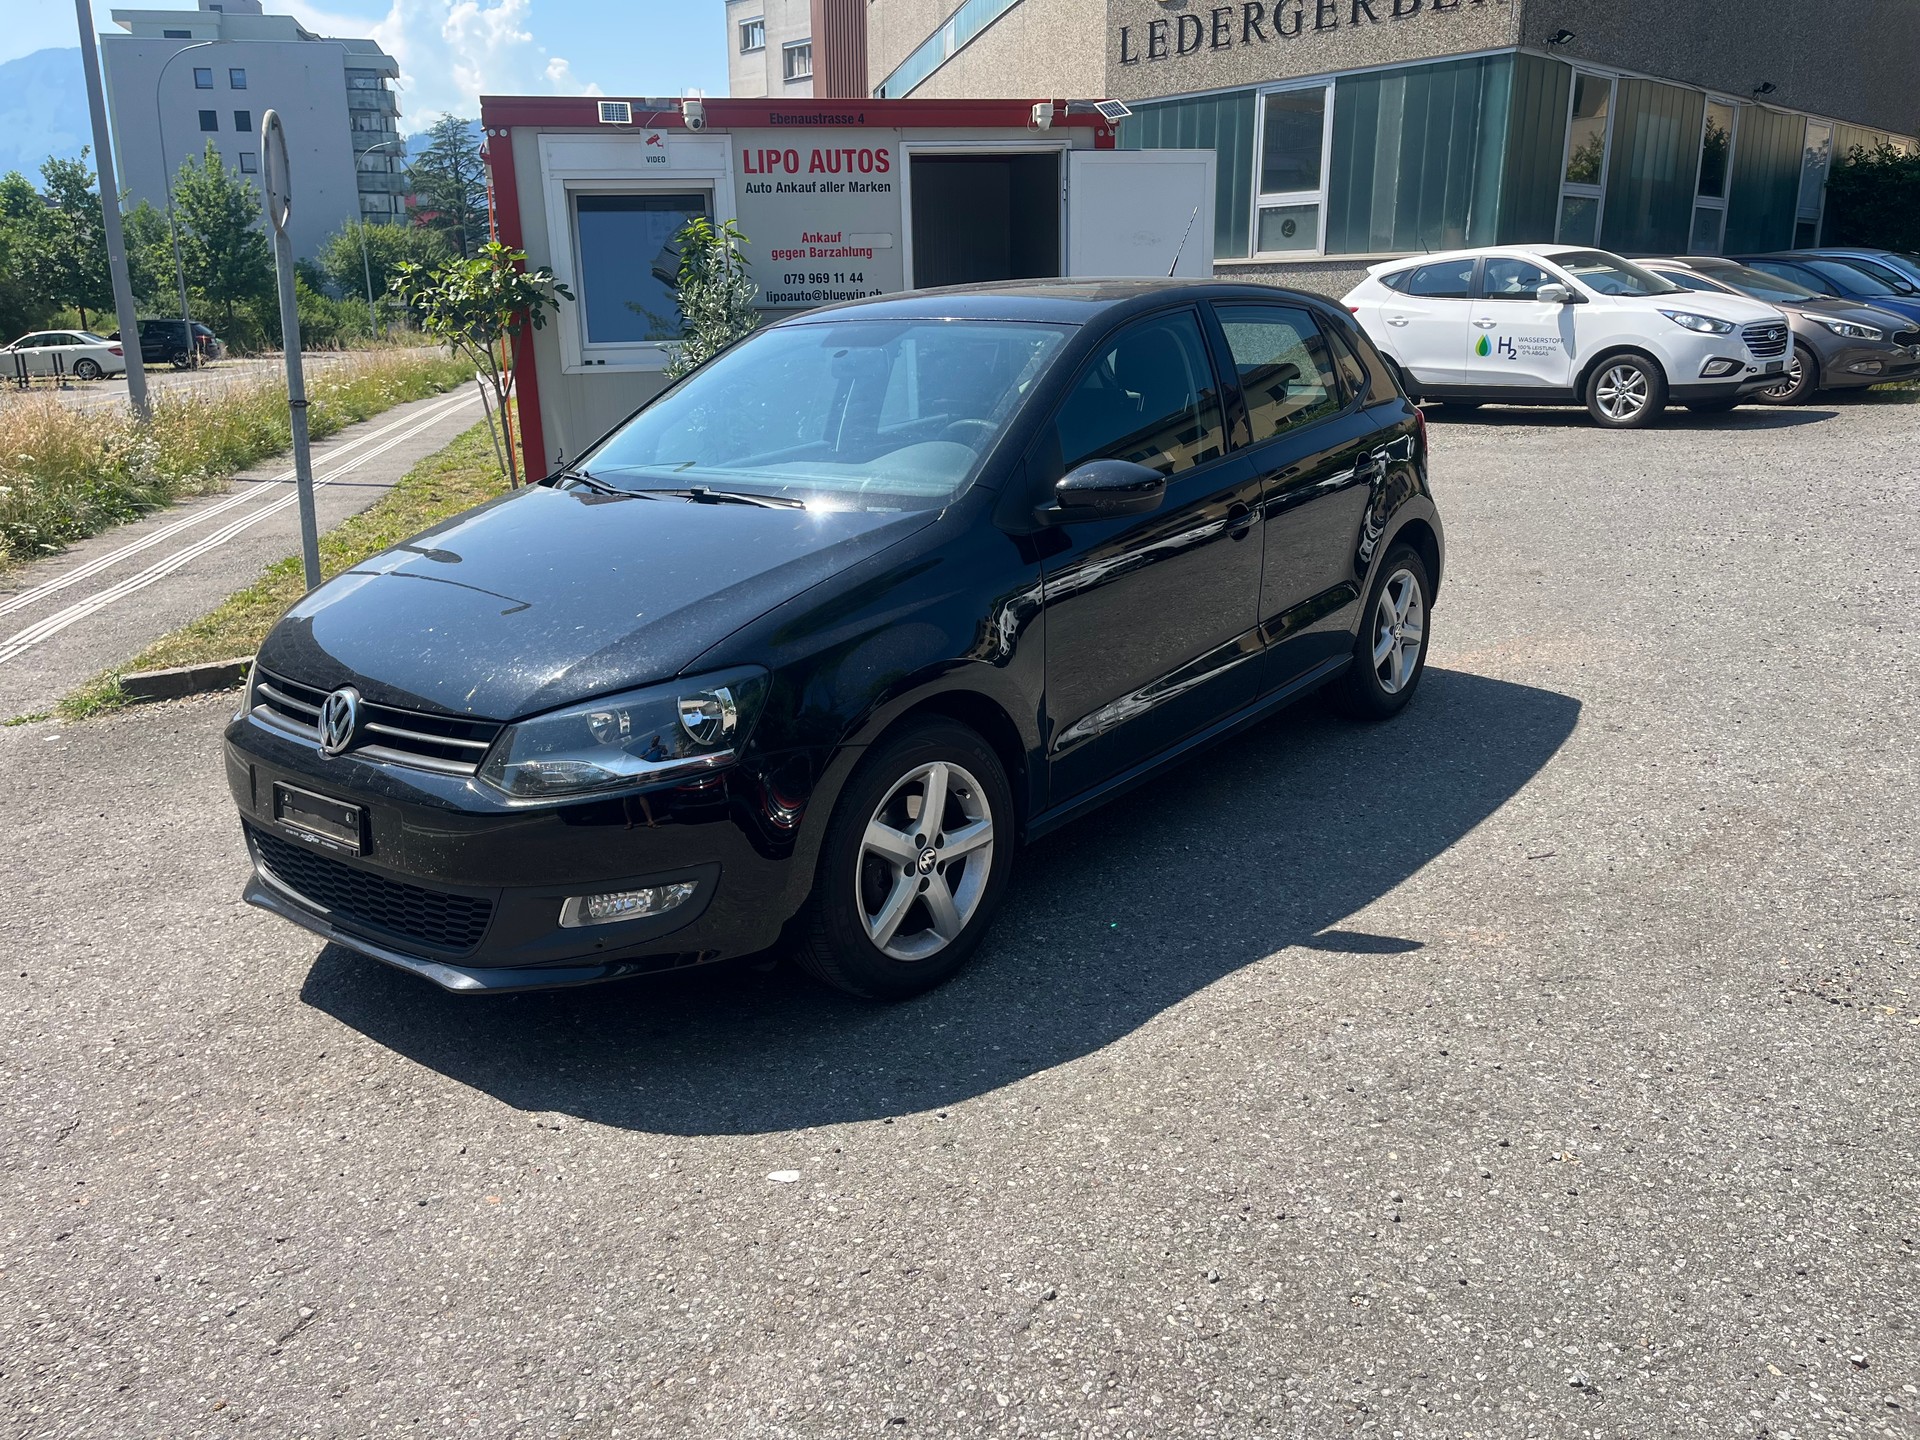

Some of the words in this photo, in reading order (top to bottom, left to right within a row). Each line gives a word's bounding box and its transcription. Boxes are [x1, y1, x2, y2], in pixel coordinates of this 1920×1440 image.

[1117, 0, 1502, 64] LEDERGER
[769, 112, 855, 125] Ebenaustrasse
[857, 113, 866, 125] 4
[645, 155, 666, 164] VIDEO
[743, 149, 800, 174] LIPO
[808, 149, 890, 174] AUTOS
[745, 182, 772, 194] Auto
[775, 181, 817, 193] Ankauf
[819, 181, 846, 193] aller
[848, 181, 891, 193] Marken
[801, 232, 842, 243] Ankauf
[771, 248, 806, 261] gegen
[809, 246, 873, 260] Barzahlung
[783, 273, 805, 285] 079
[808, 272, 830, 284] 969
[834, 272, 845, 284] 11
[849, 272, 864, 283] 44
[766, 288, 882, 304] lipoauto@bluewinch
